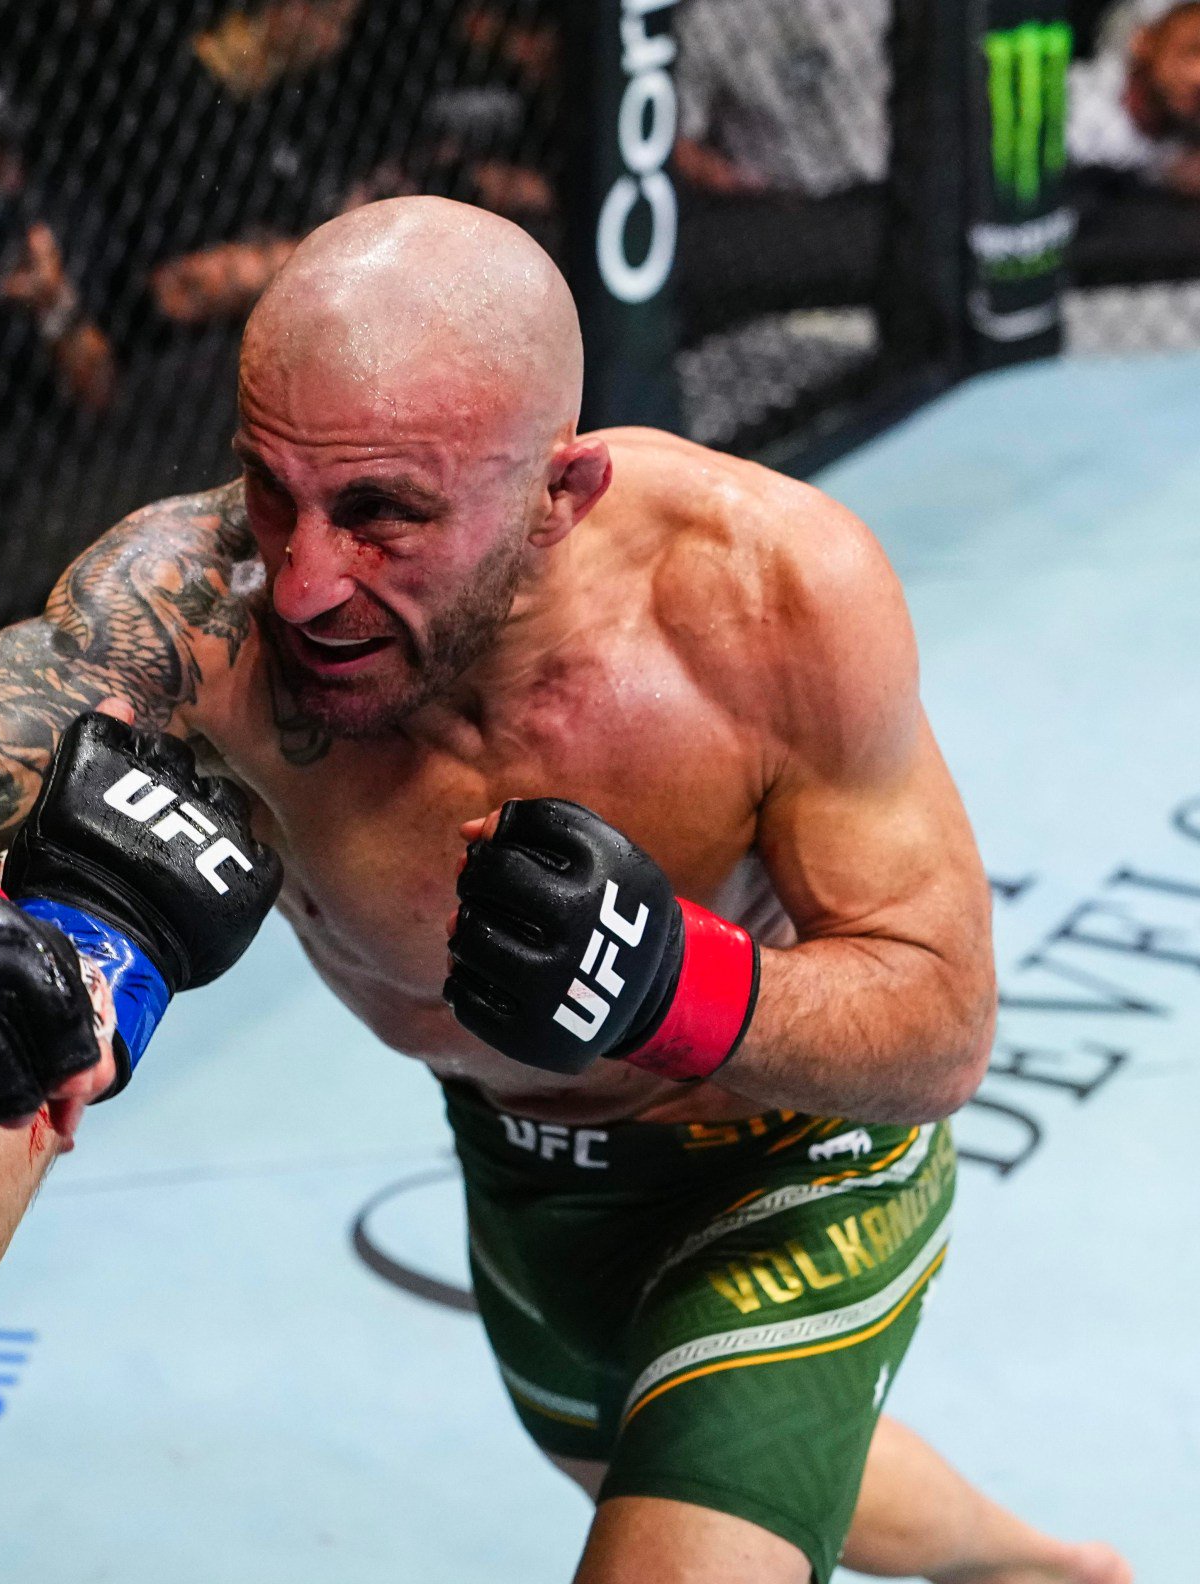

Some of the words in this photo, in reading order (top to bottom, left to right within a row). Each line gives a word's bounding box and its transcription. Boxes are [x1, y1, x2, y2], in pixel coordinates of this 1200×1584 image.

[103, 768, 253, 895] UFC
[552, 879, 650, 1042] UFC
[499, 1114, 610, 1168] UFC
